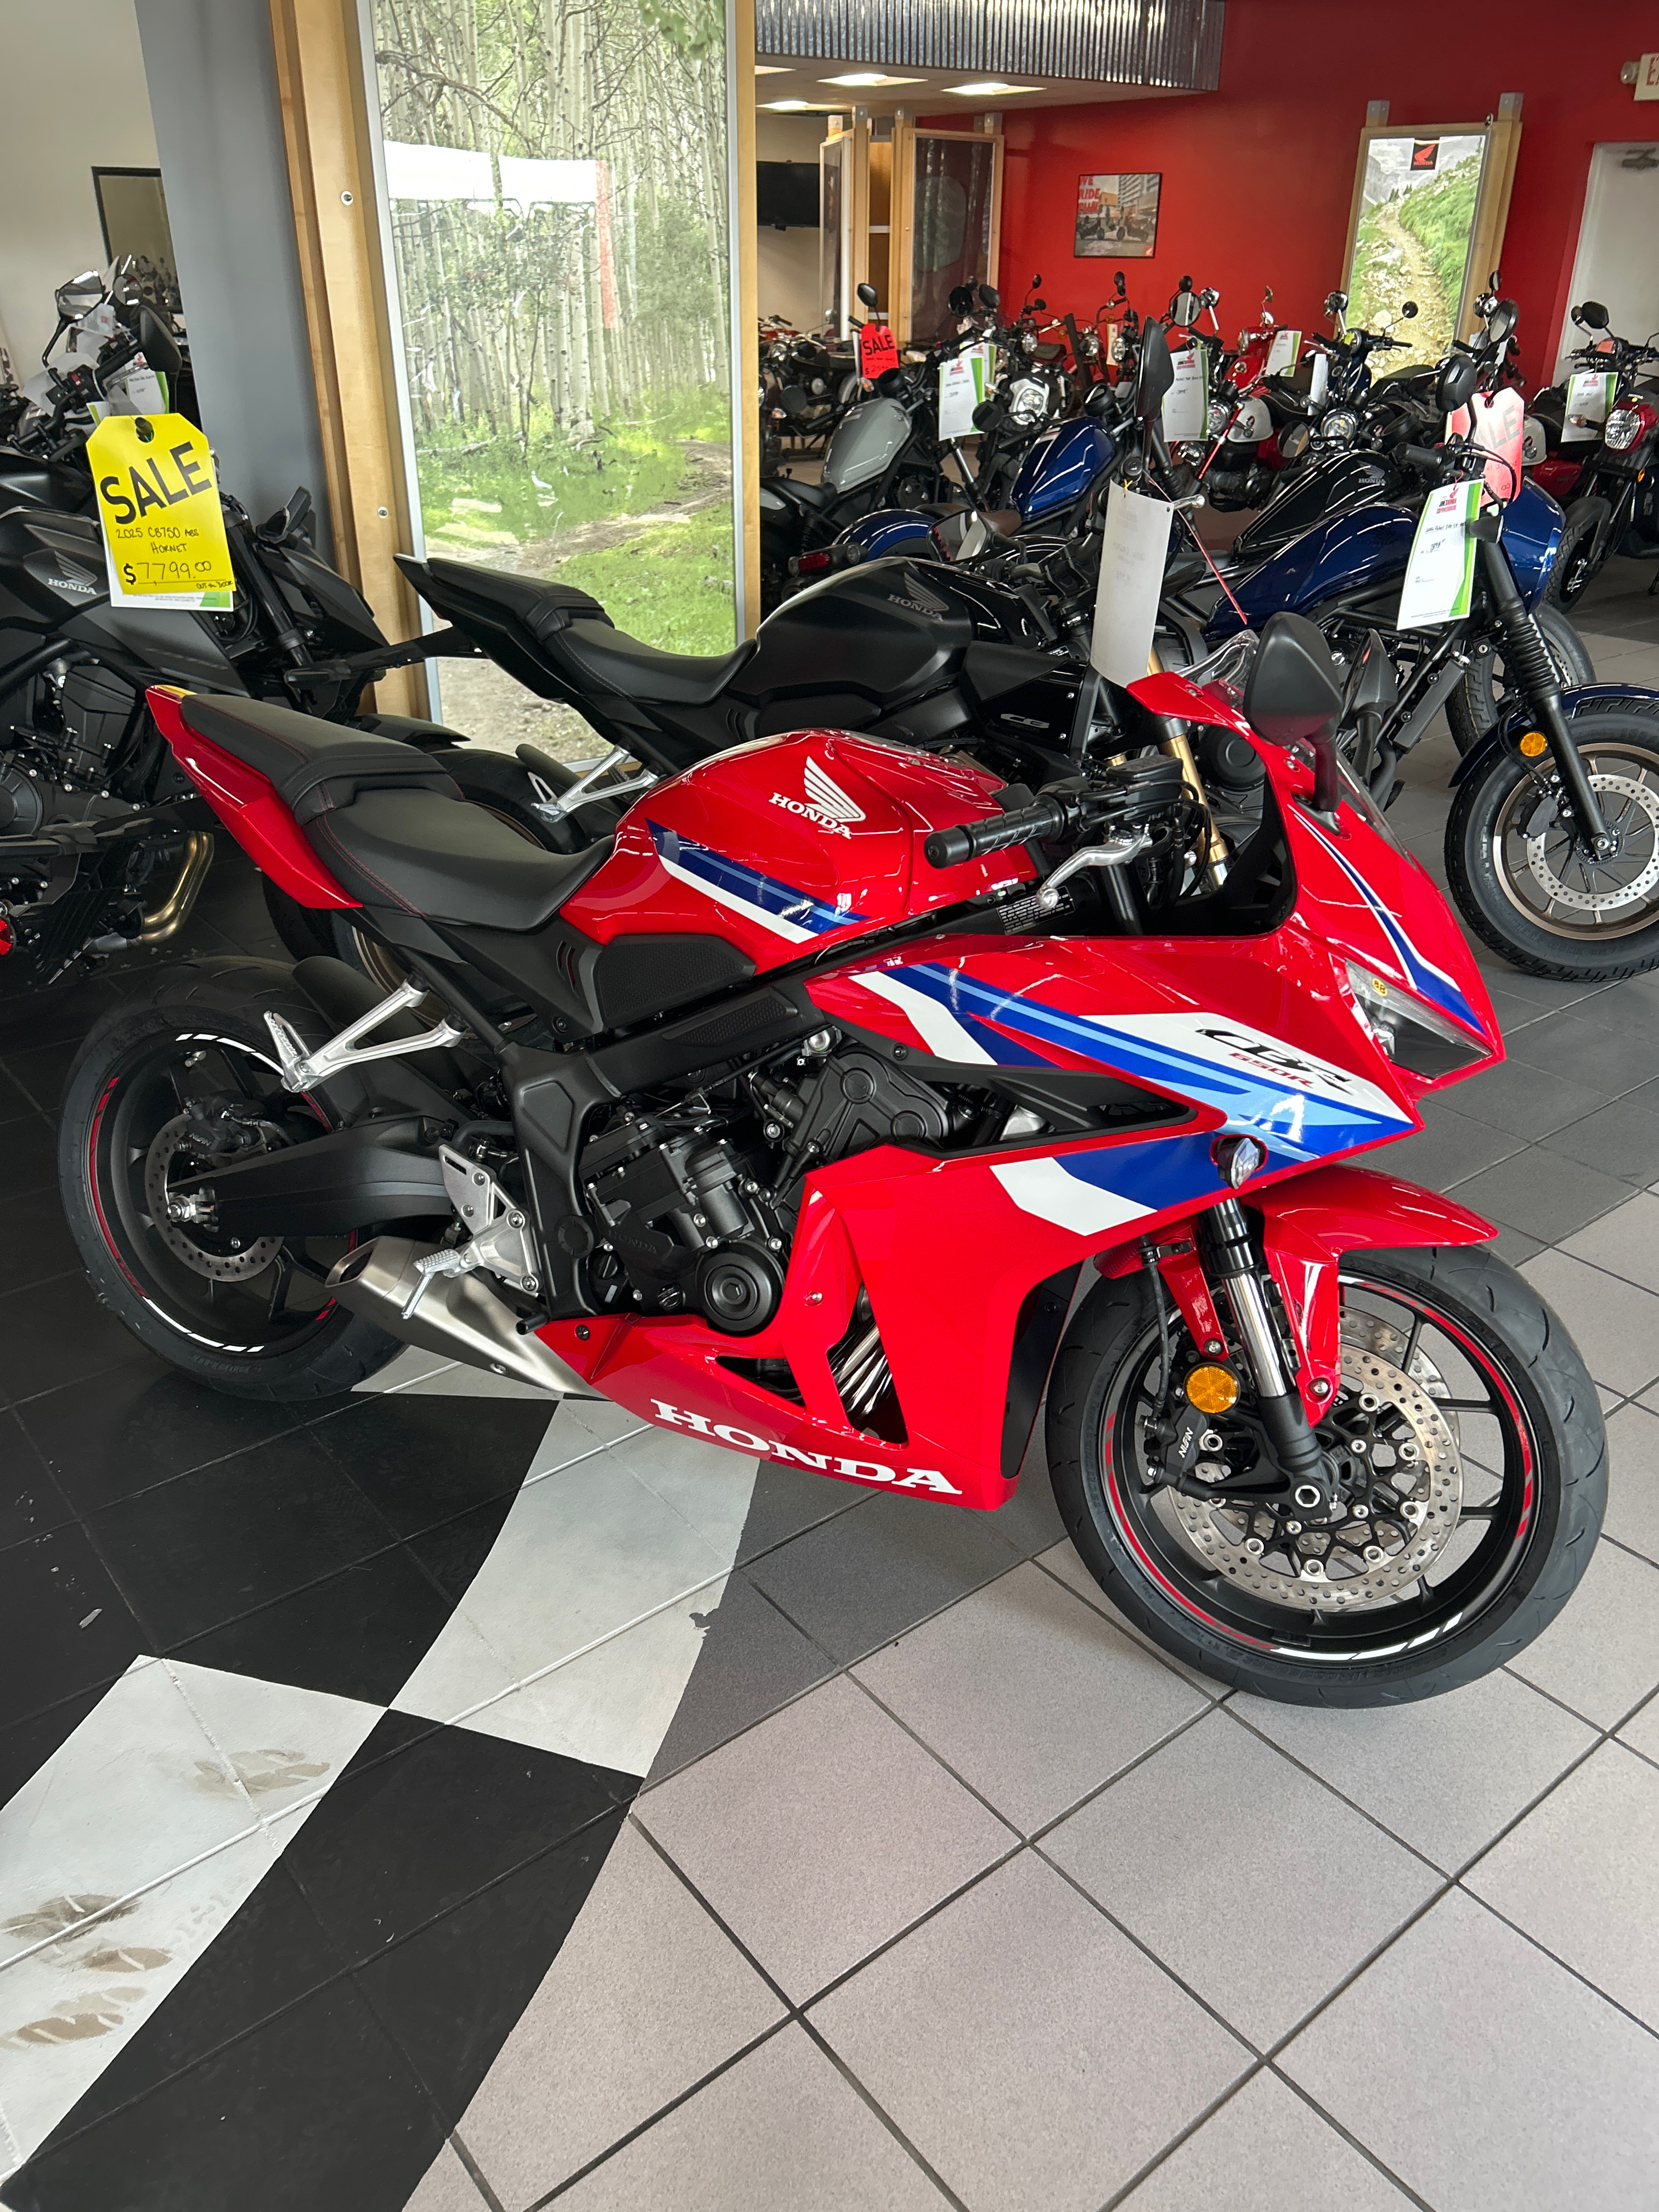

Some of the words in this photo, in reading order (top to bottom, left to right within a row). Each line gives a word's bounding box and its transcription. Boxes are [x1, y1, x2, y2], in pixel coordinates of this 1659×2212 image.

[862, 335, 895, 356] SALE
[100, 441, 212, 524] SALE
[116, 528, 143, 538] 2025
[148, 527, 180, 538] CB750
[151, 541, 187, 554] HORNET
[48, 578, 97, 595] HONDA
[887, 594, 944, 622] HONDA
[1001, 714, 1050, 729] CB
[769, 792, 851, 840] HONDA
[1195, 1029, 1353, 1095] CBR
[1228, 1052, 1313, 1088] 650R
[608, 1229, 658, 1255] HONDA
[650, 1398, 963, 1495] HONDA
[1178, 1426, 1193, 1459] NISSIN
